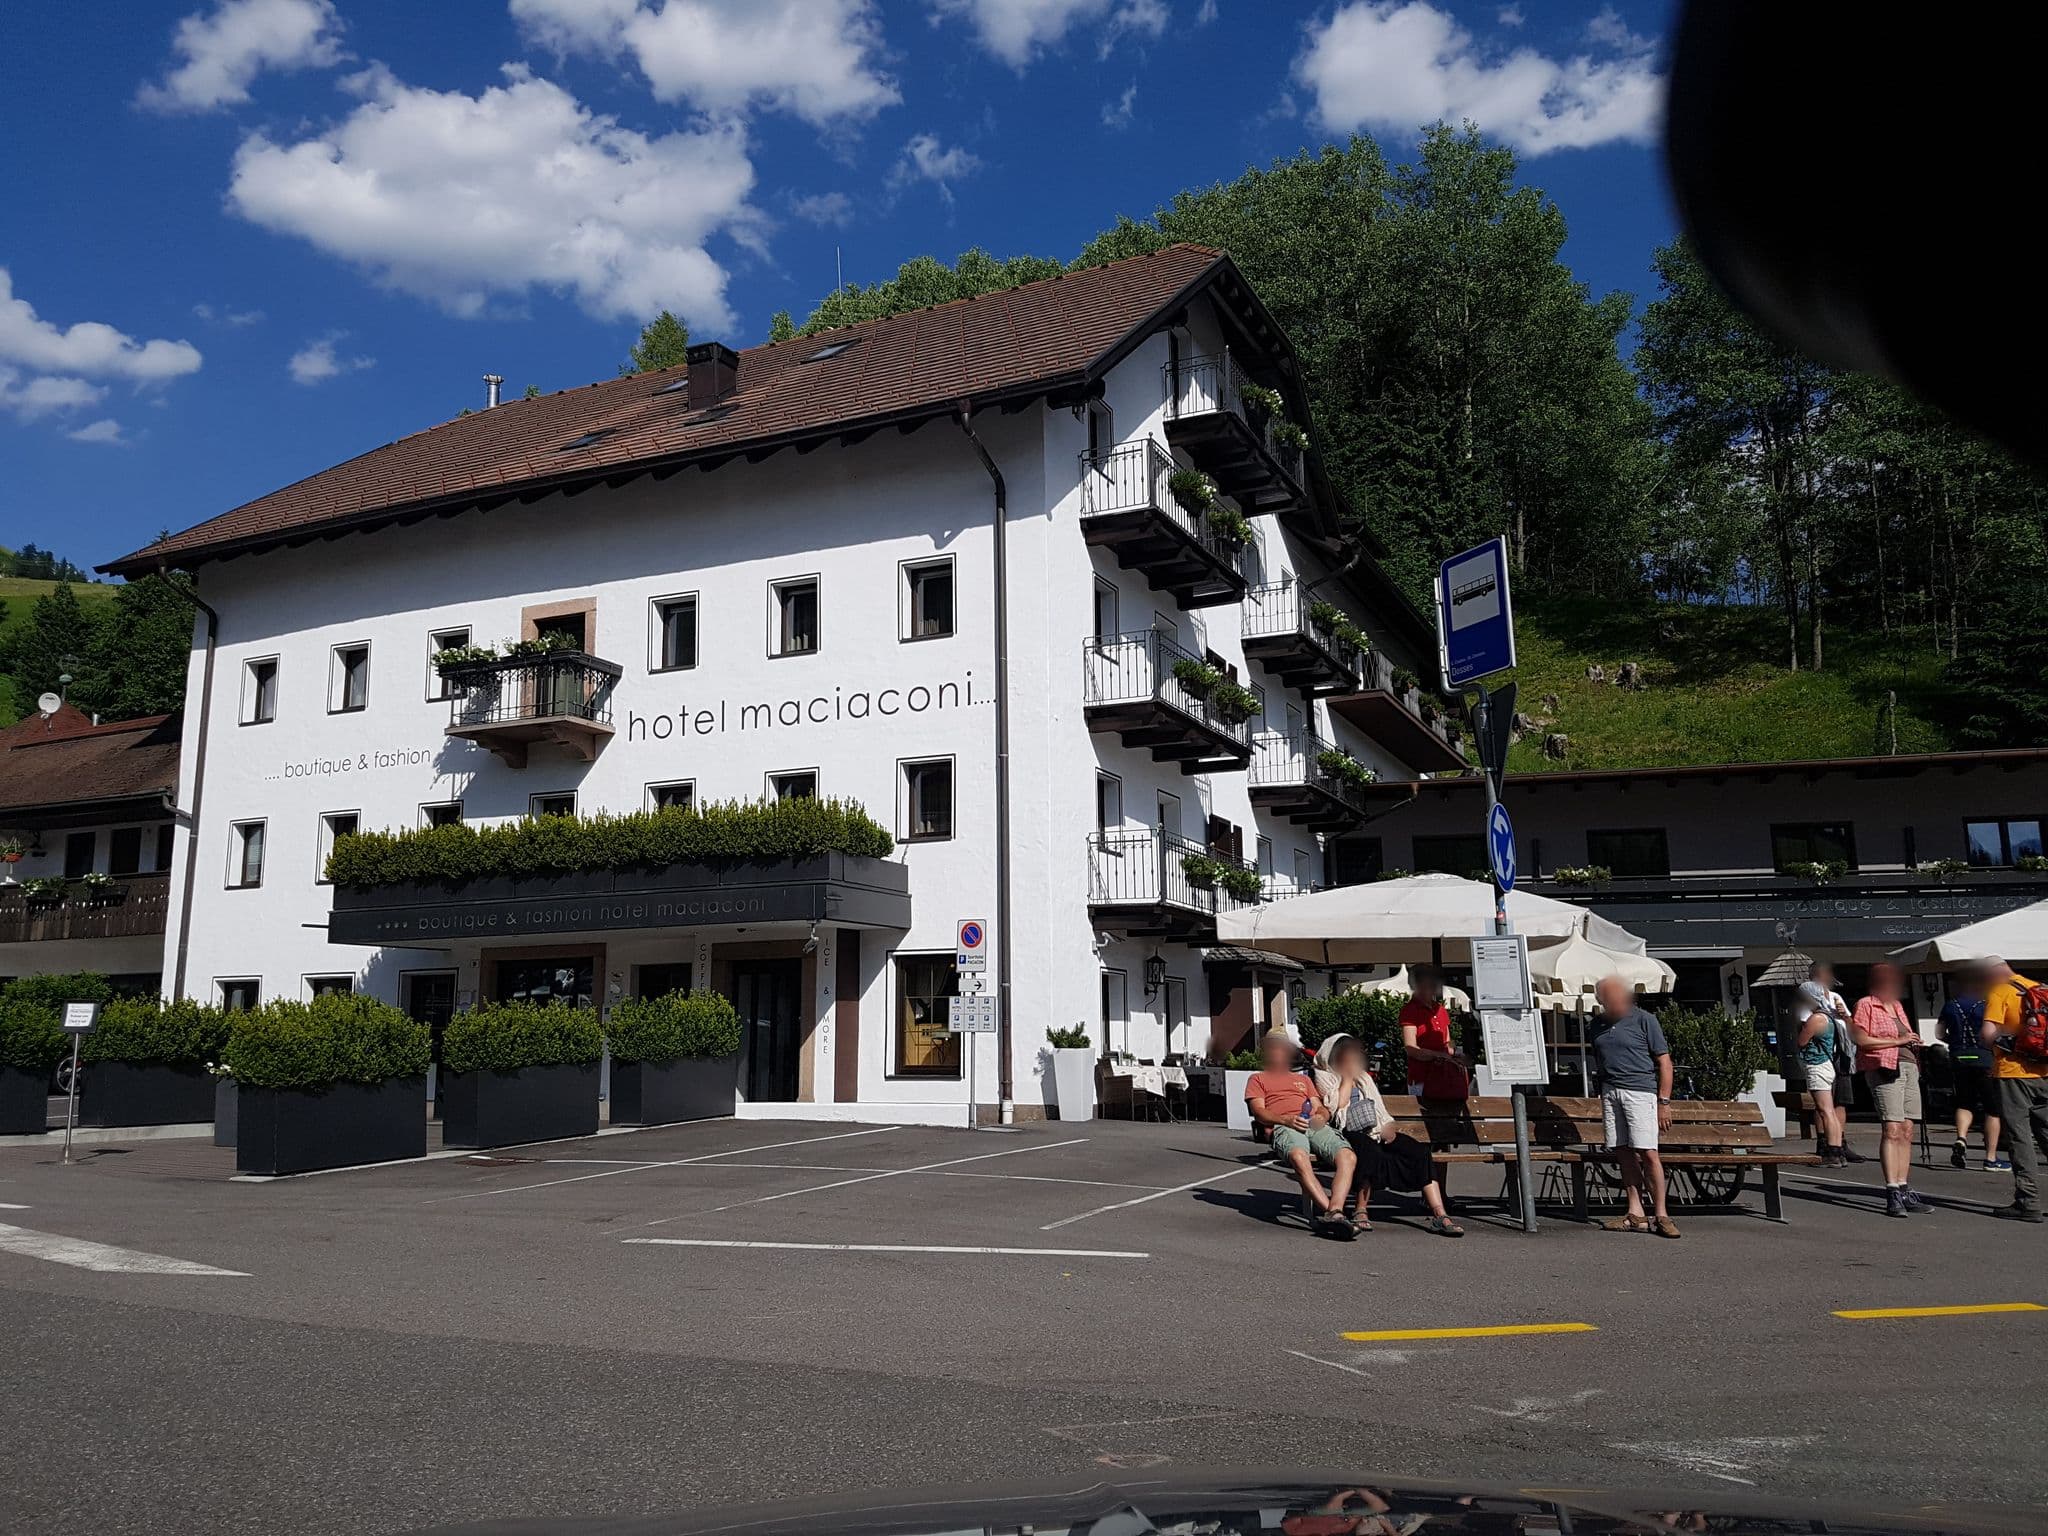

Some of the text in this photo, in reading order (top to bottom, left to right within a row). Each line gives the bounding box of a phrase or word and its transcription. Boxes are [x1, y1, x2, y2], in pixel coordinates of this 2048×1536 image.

[628, 700, 726, 742] hotel
[284, 758, 352, 778] boutique
[357, 753, 369, 770] &
[374, 747, 431, 768] fashion
[418, 912, 497, 931] boutique
[506, 911, 517, 925] &
[600, 904, 649, 920] hotel
[657, 898, 765, 917] maciaconi
[699, 943, 707, 992] COFFE
[823, 938, 831, 967] ICE
[822, 1015, 832, 1054] MORE
